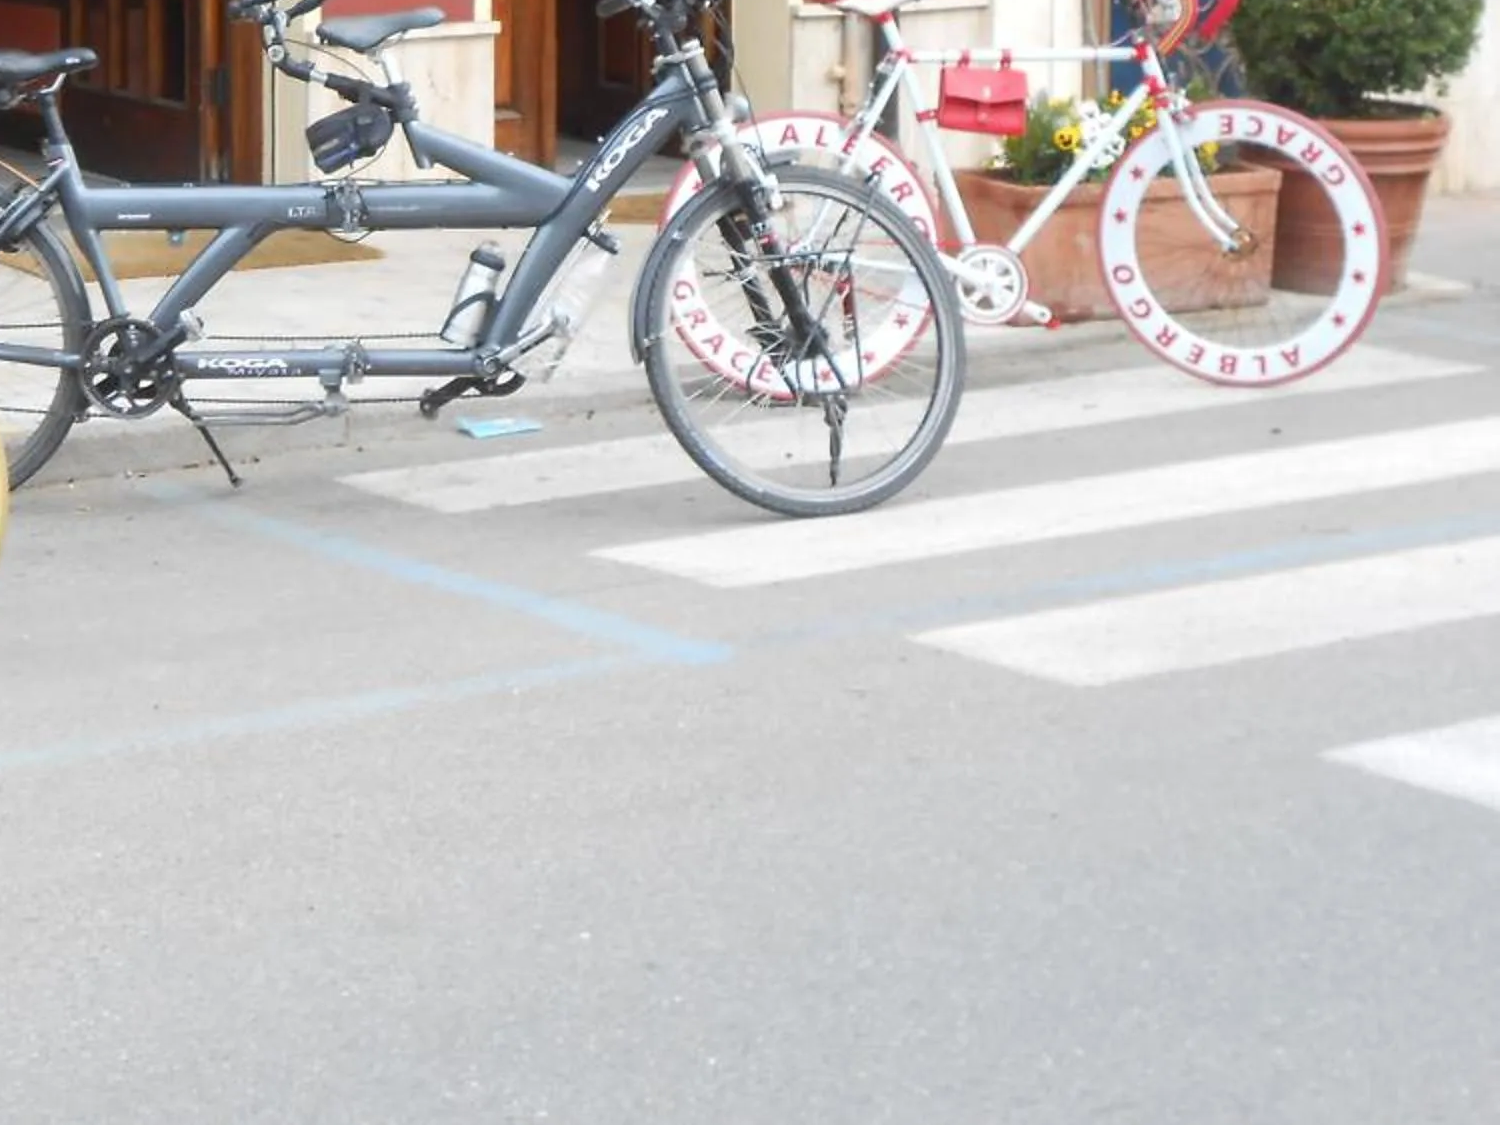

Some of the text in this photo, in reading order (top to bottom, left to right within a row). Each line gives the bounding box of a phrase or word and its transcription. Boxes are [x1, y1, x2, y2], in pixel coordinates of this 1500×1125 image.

[586, 107, 670, 192] KOGA
[1219, 114, 1346, 187] GRACE
[1112, 264, 1302, 376] ALBERGO
[197, 357, 288, 370] KOGA
